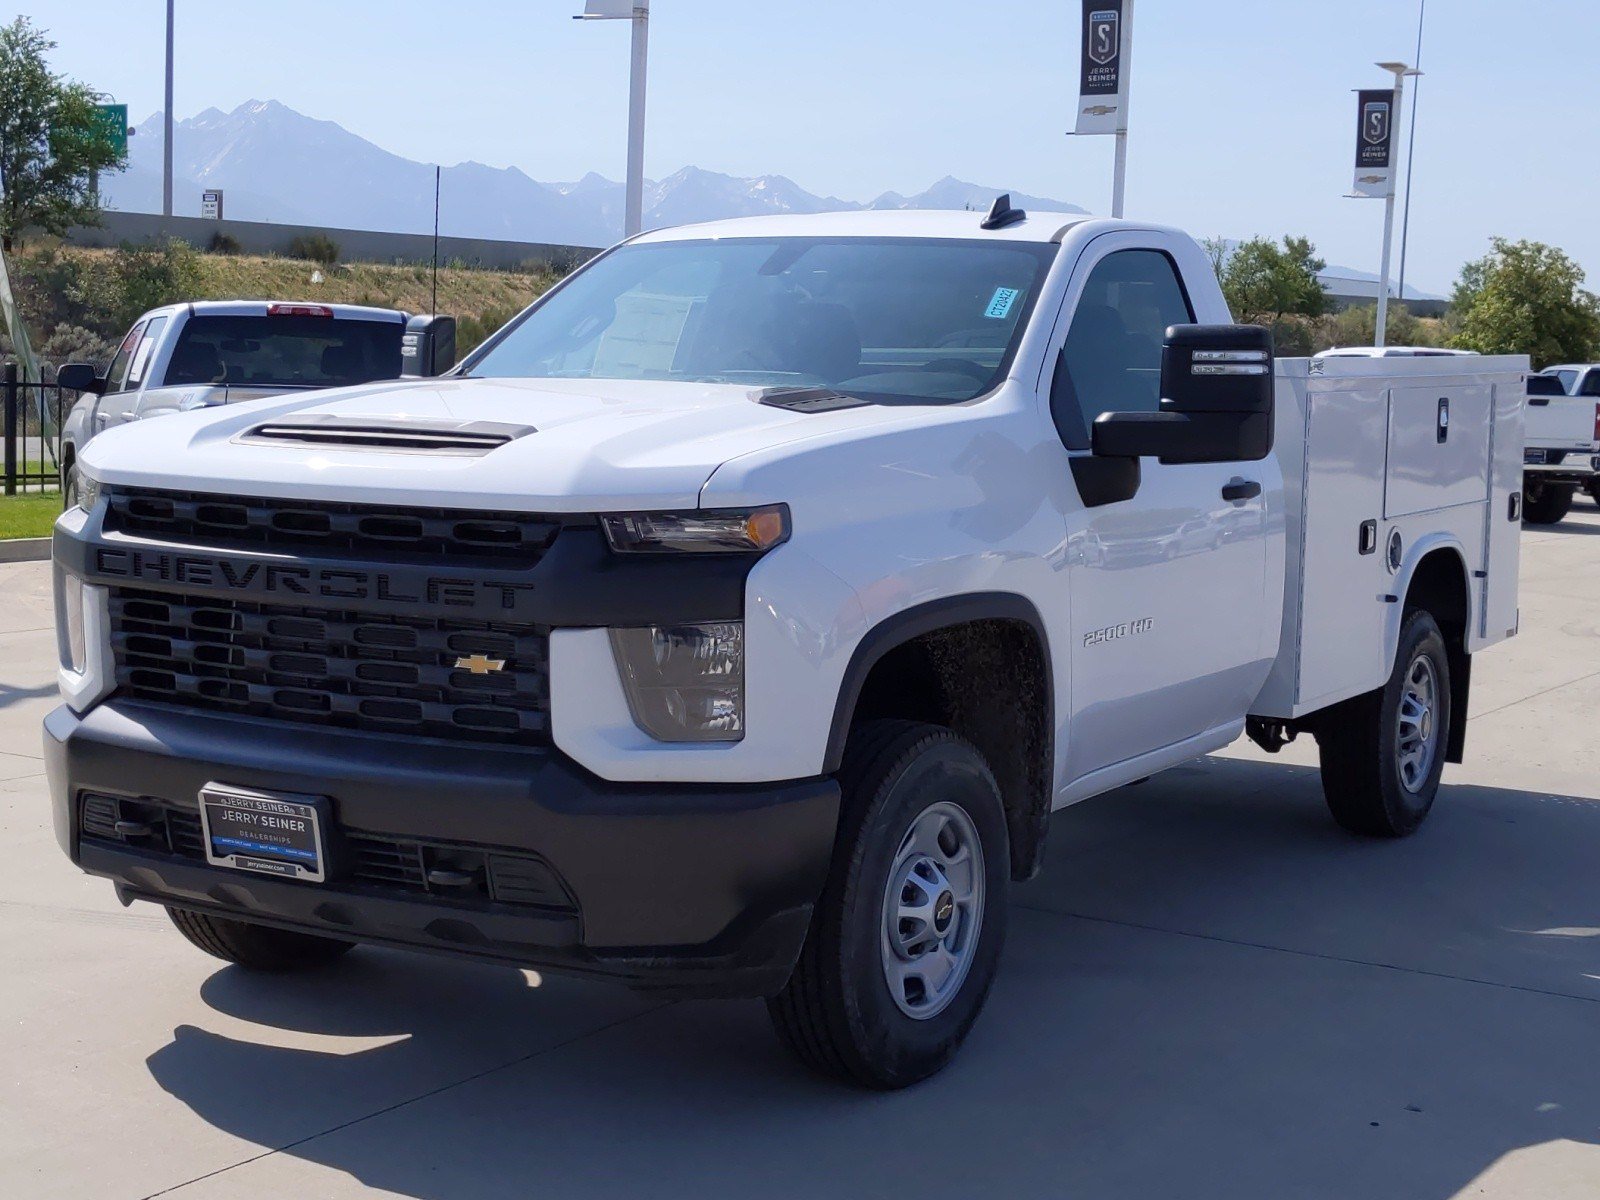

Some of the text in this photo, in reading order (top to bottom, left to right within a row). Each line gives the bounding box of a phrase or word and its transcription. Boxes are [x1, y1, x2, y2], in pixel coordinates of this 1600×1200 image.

[1098, 24, 1110, 53] S
[1371, 112, 1382, 135] S
[990, 289, 1014, 315] CT20422
[96, 548, 535, 609] CHEVROLET
[1084, 617, 1152, 647] 2500 HD
[227, 797, 253, 808] JERRY
[256, 801, 290, 813] SEINER
[222, 810, 305, 832] JERRY SEINER
[239, 830, 291, 844] DEALERSHIPS
[247, 860, 285, 872] jerryseiner.com
